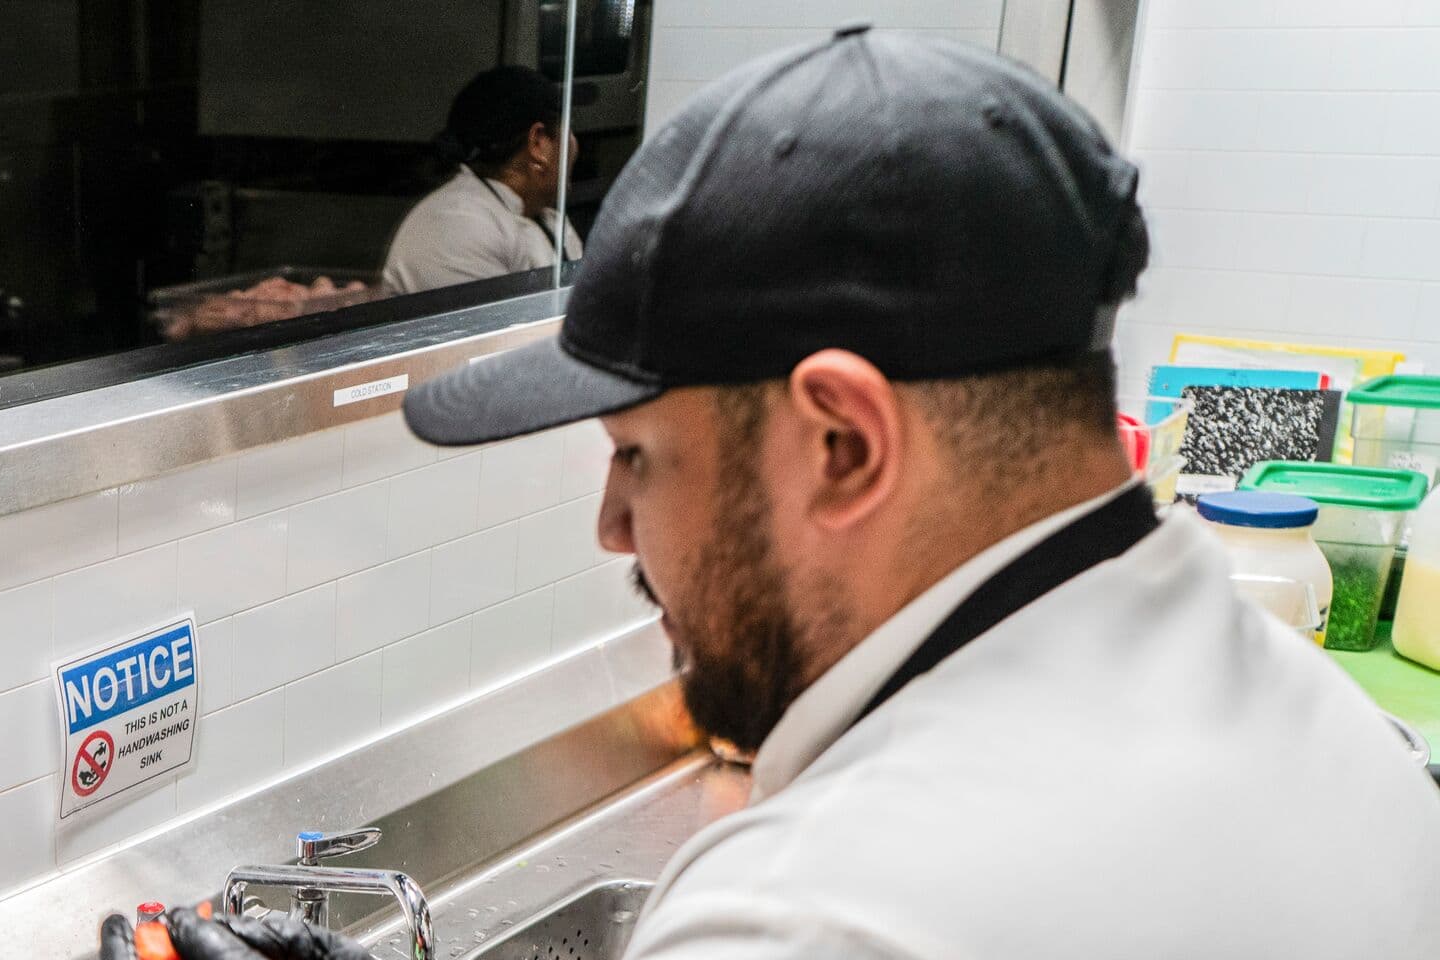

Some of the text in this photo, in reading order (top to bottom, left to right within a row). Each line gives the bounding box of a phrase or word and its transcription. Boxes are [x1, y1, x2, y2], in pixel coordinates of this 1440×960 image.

[66, 635, 193, 724] NOTICE
[125, 699, 188, 735] THIS IS NOT A
[118, 718, 190, 759] HANDWASHING
[140, 750, 163, 769] SINK
